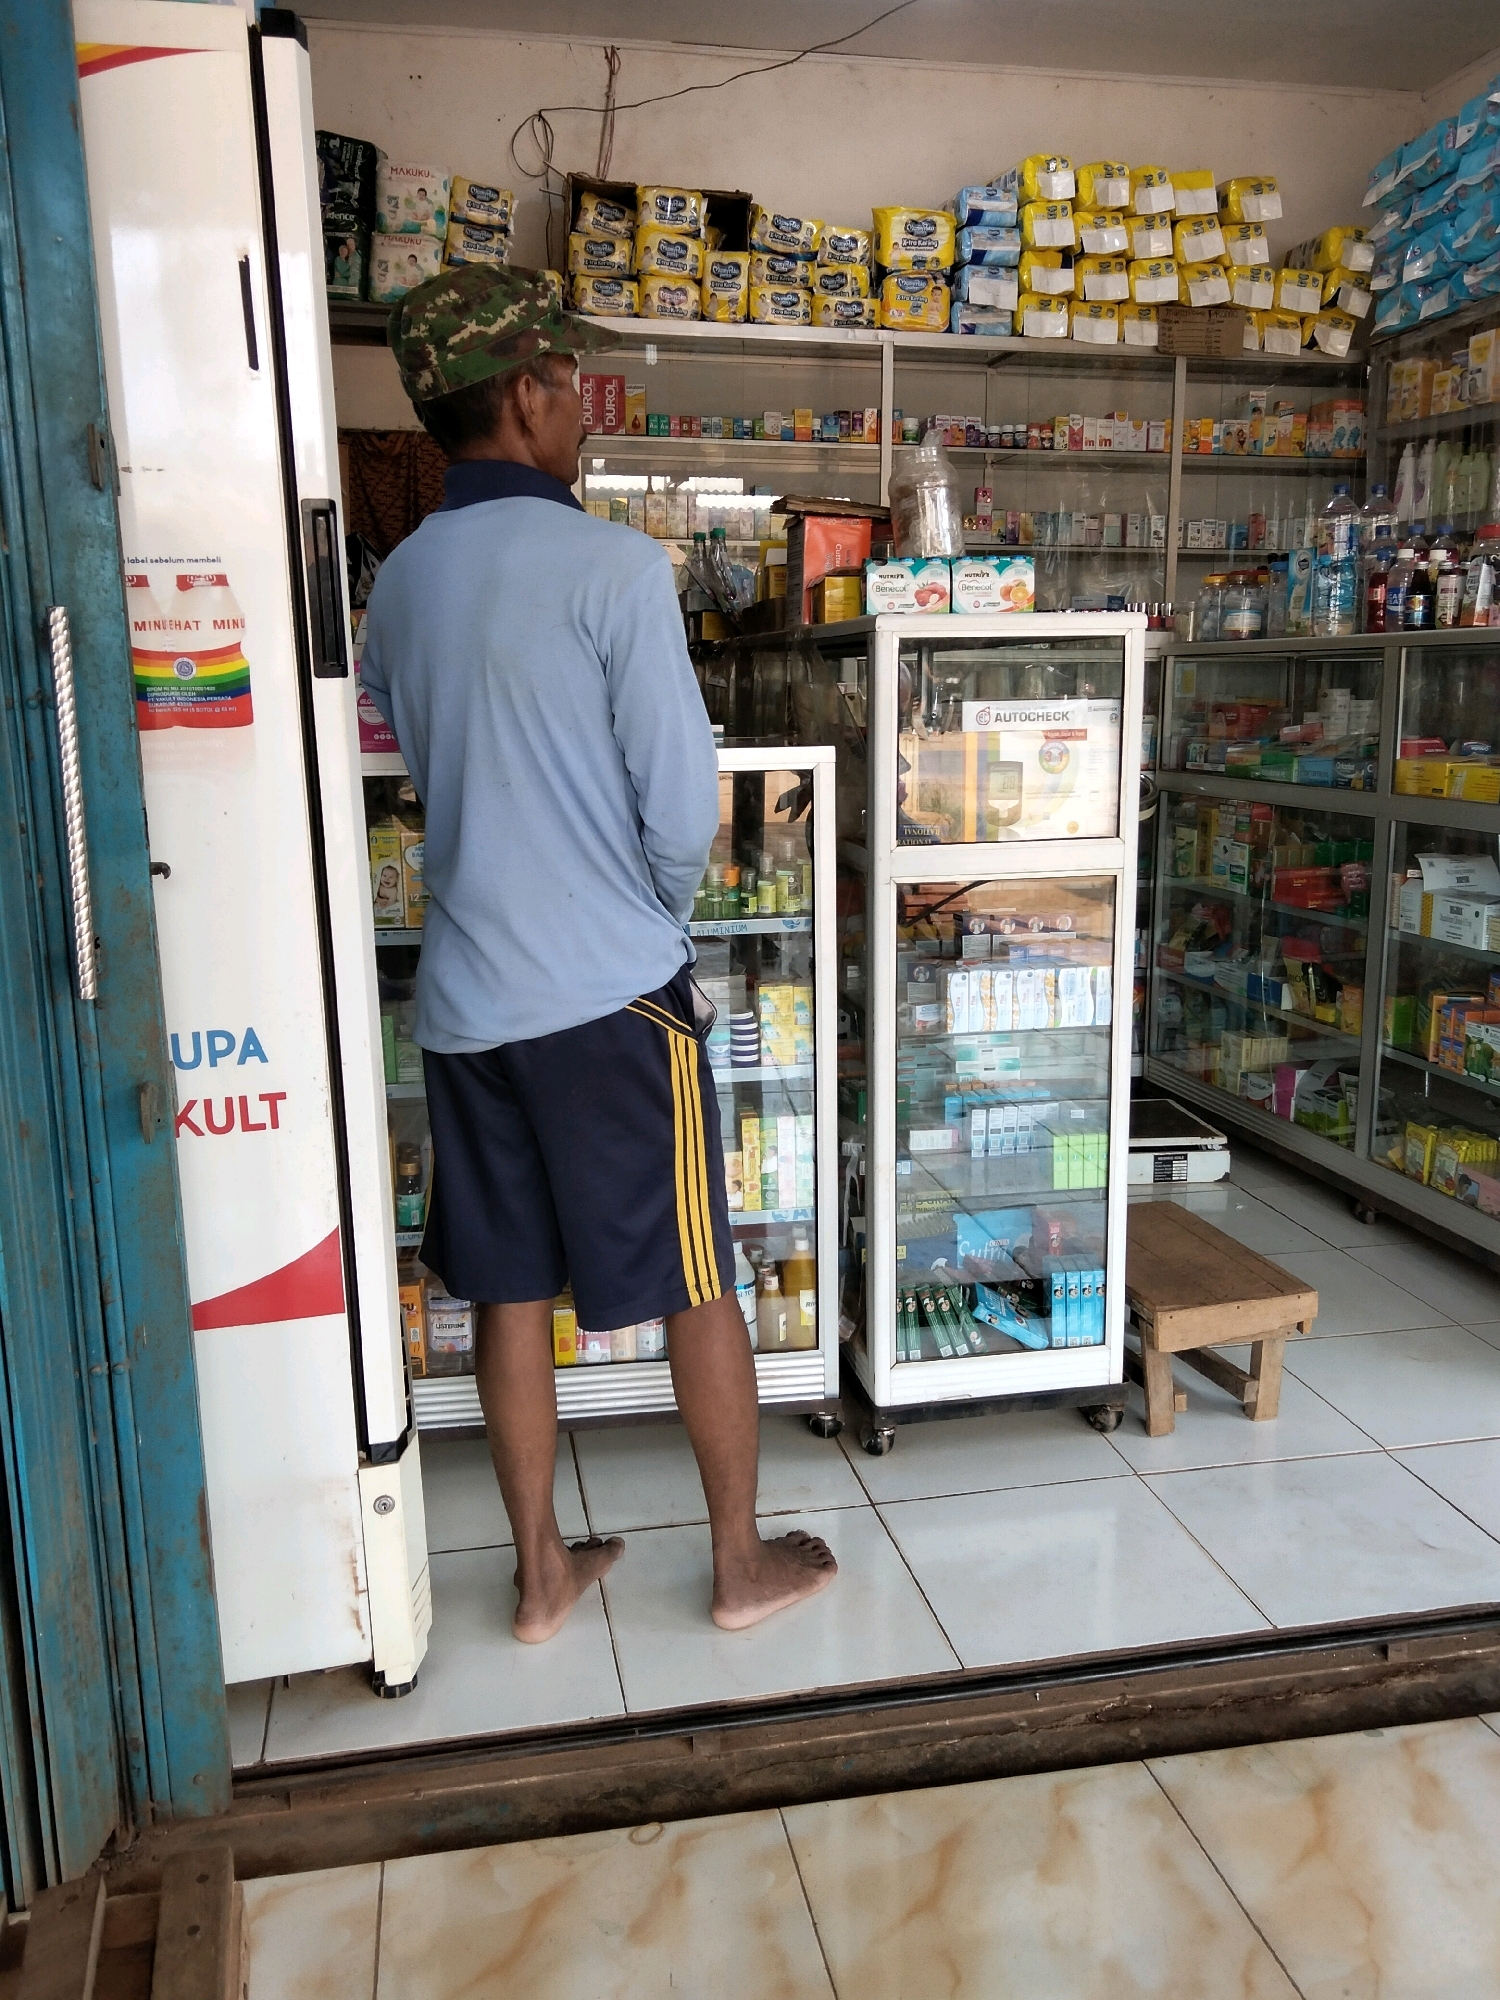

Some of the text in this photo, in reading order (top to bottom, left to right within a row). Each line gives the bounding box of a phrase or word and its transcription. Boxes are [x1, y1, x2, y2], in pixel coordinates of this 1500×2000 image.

[391, 166, 430, 178] MAKUKU
[583, 378, 593, 425] DUROL
[606, 379, 617, 426] DUROL
[994, 711, 1070, 722] AUTOCHECK
[170, 1027, 269, 1070] UPA
[175, 1092, 287, 1138] KULT
